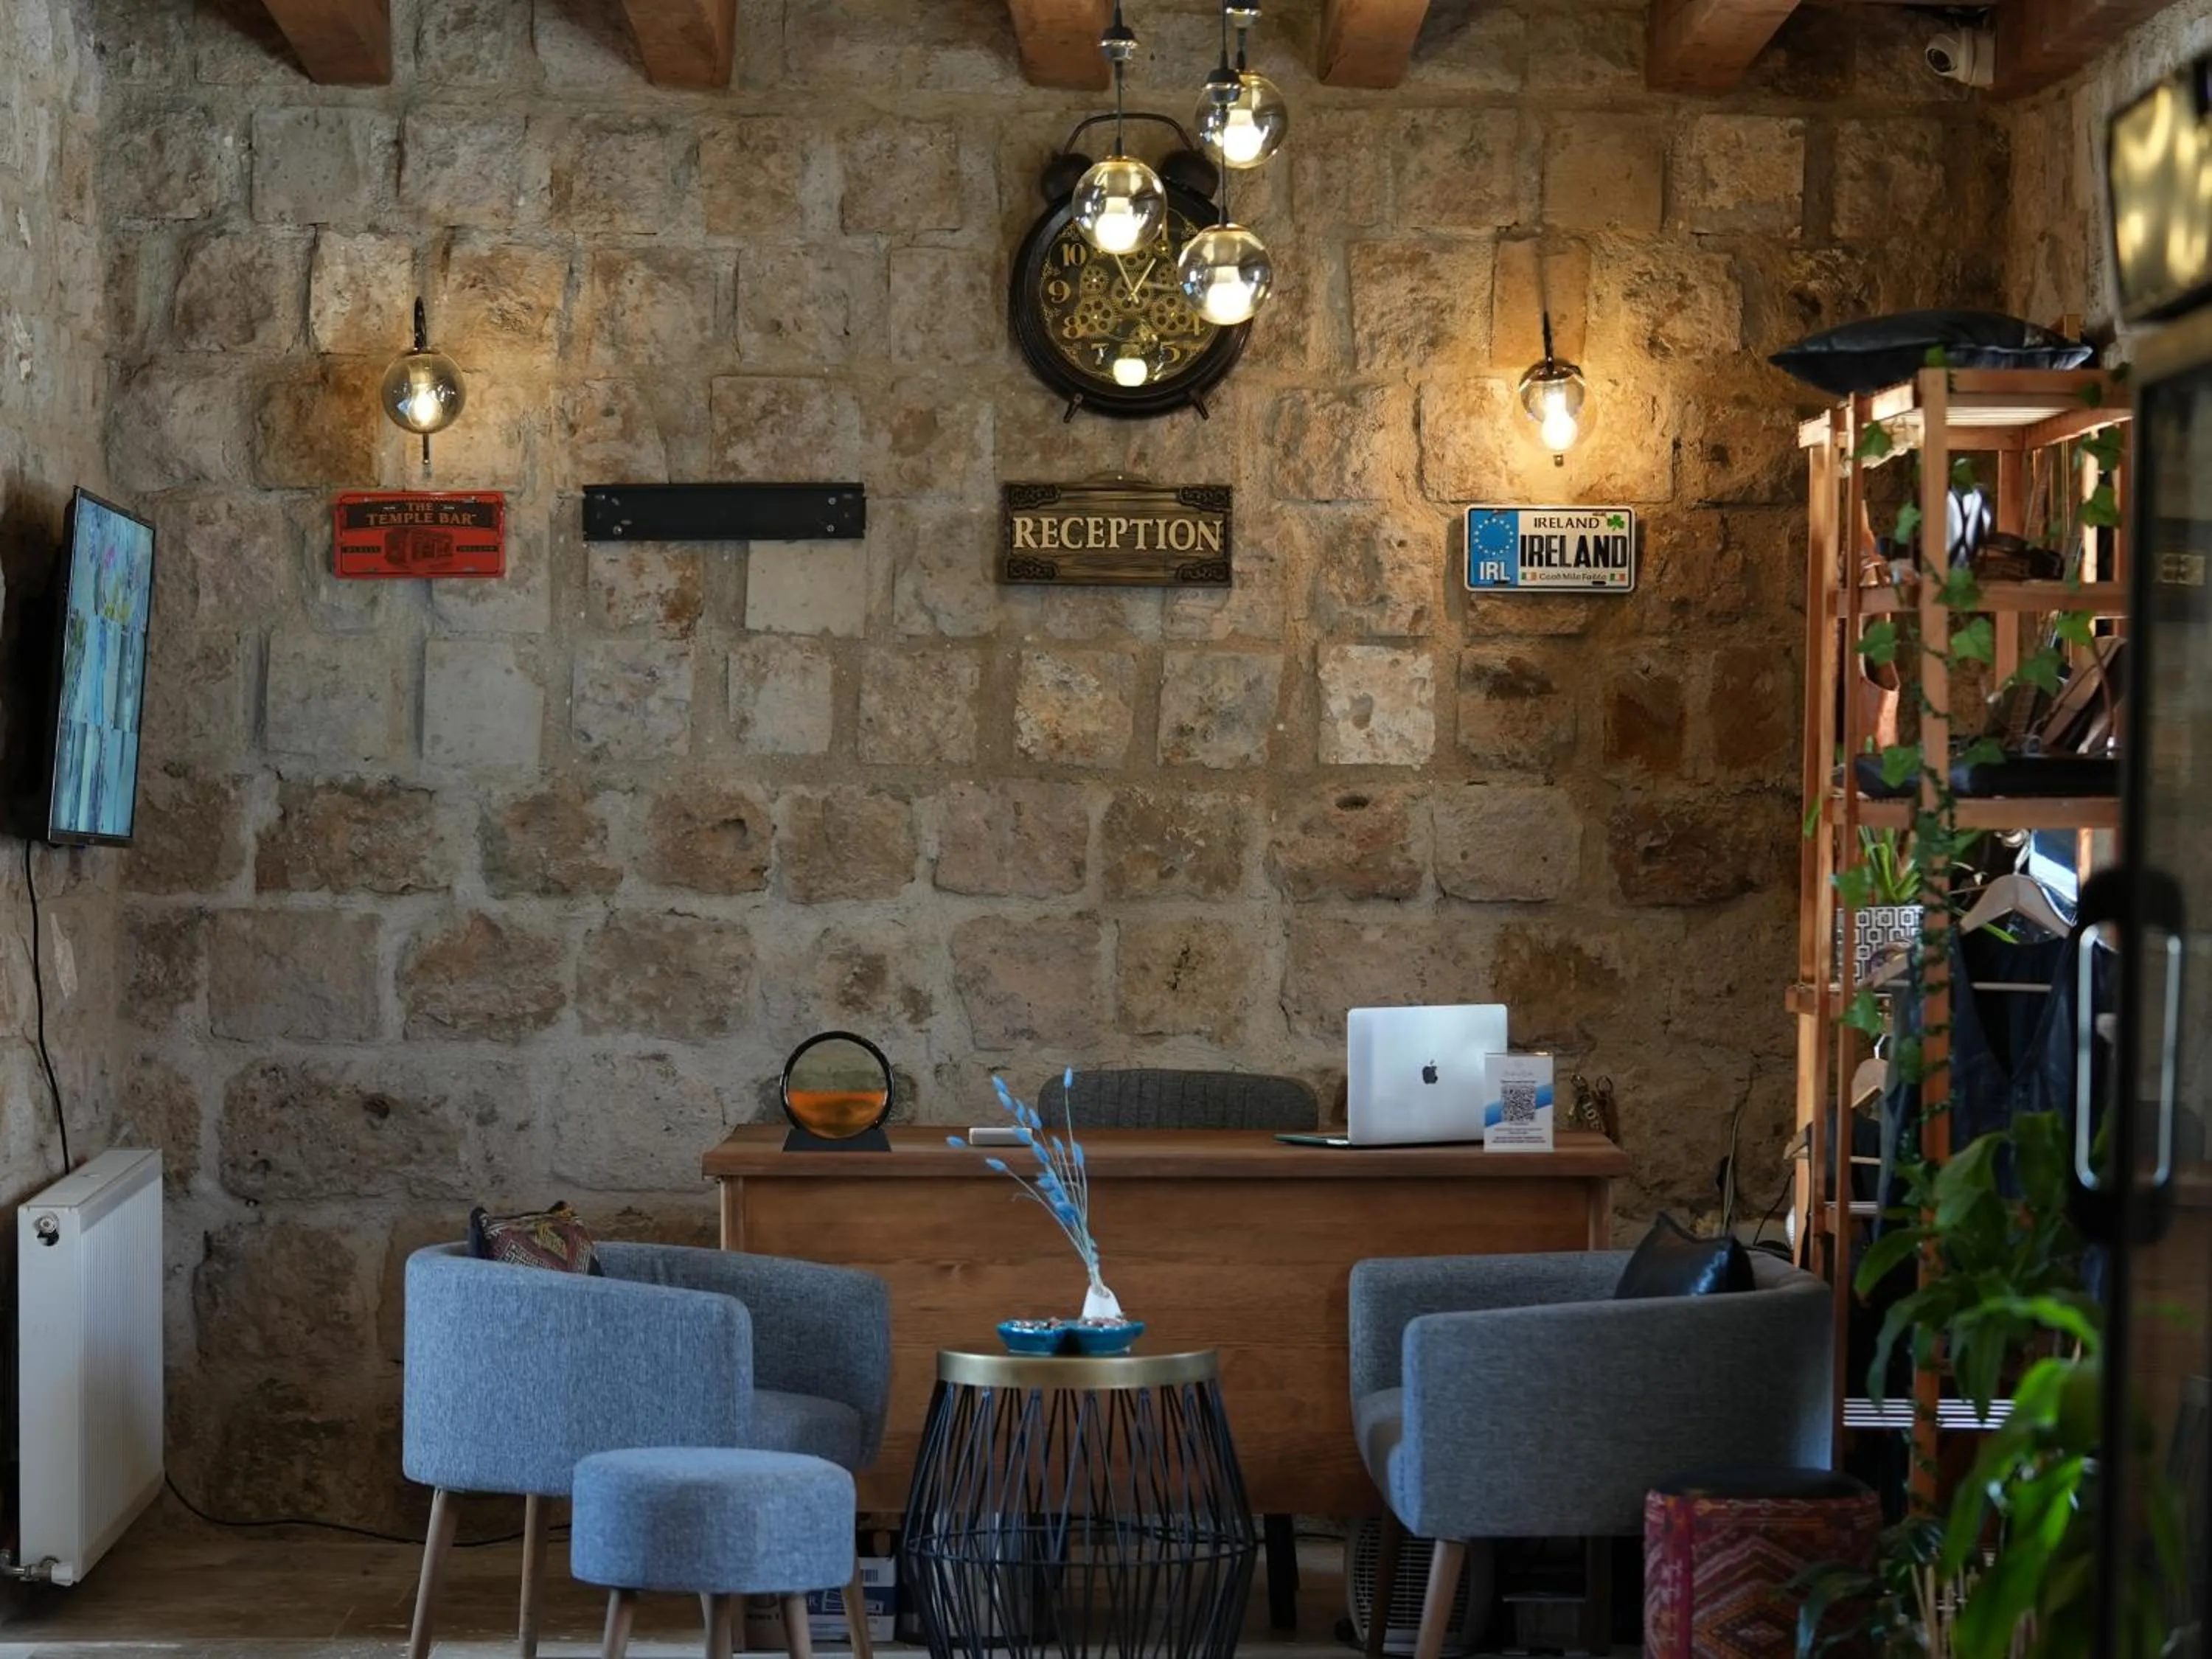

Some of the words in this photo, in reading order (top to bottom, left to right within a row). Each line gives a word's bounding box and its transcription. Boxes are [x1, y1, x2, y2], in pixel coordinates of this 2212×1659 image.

[1062, 243, 1087, 267] 10
[1048, 280, 1071, 304] 9
[1091, 343, 1109, 366] 7
[1159, 341, 1180, 364] 5
[407, 502, 434, 512] THE
[366, 512, 434, 526] TEMPLE
[1534, 517, 1600, 529] IRELAND
[1013, 516, 1223, 552] RECEPTION
[1520, 534, 1627, 568] IRELAND
[1479, 561, 1511, 581] IRL
